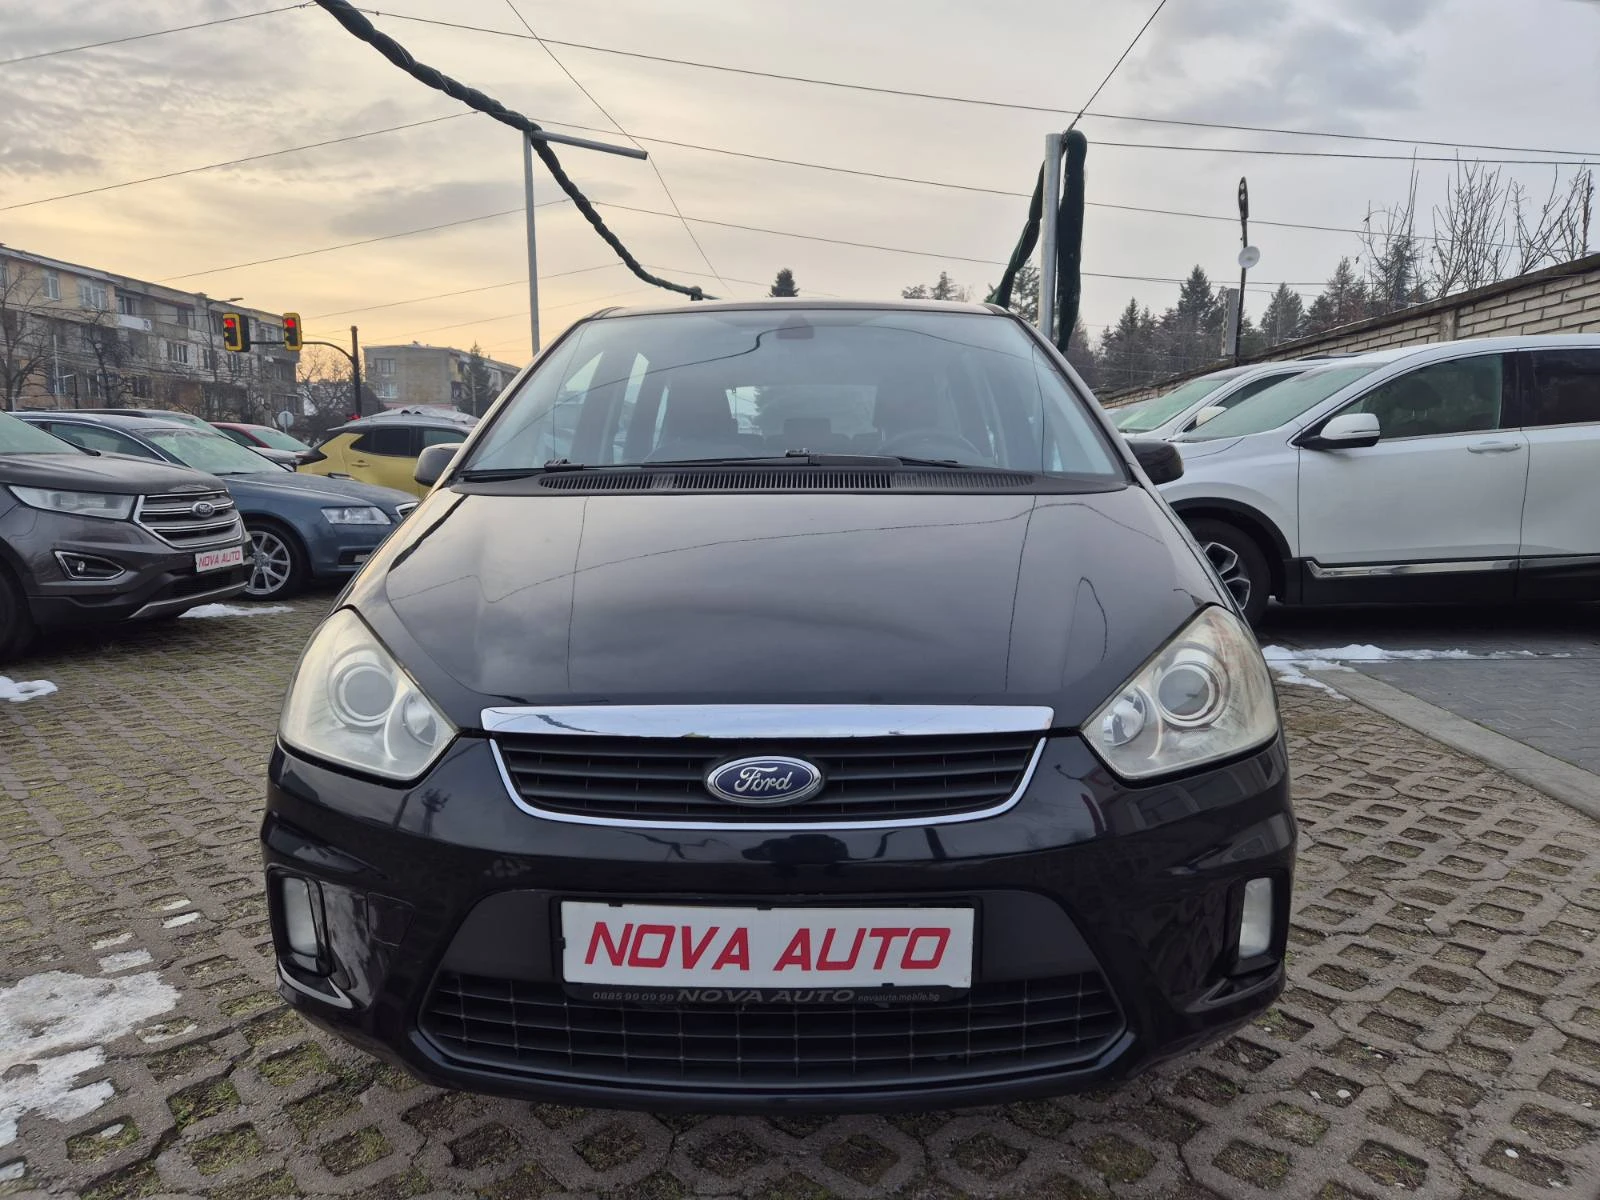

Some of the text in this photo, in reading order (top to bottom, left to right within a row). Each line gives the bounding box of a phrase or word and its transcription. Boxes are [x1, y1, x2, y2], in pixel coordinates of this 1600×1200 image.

[199, 550, 240, 568] NOVA AUTO
[734, 766, 793, 792] Ford
[584, 921, 951, 971] NOVA AUTO
[676, 988, 855, 1002] NOVA AUTO
